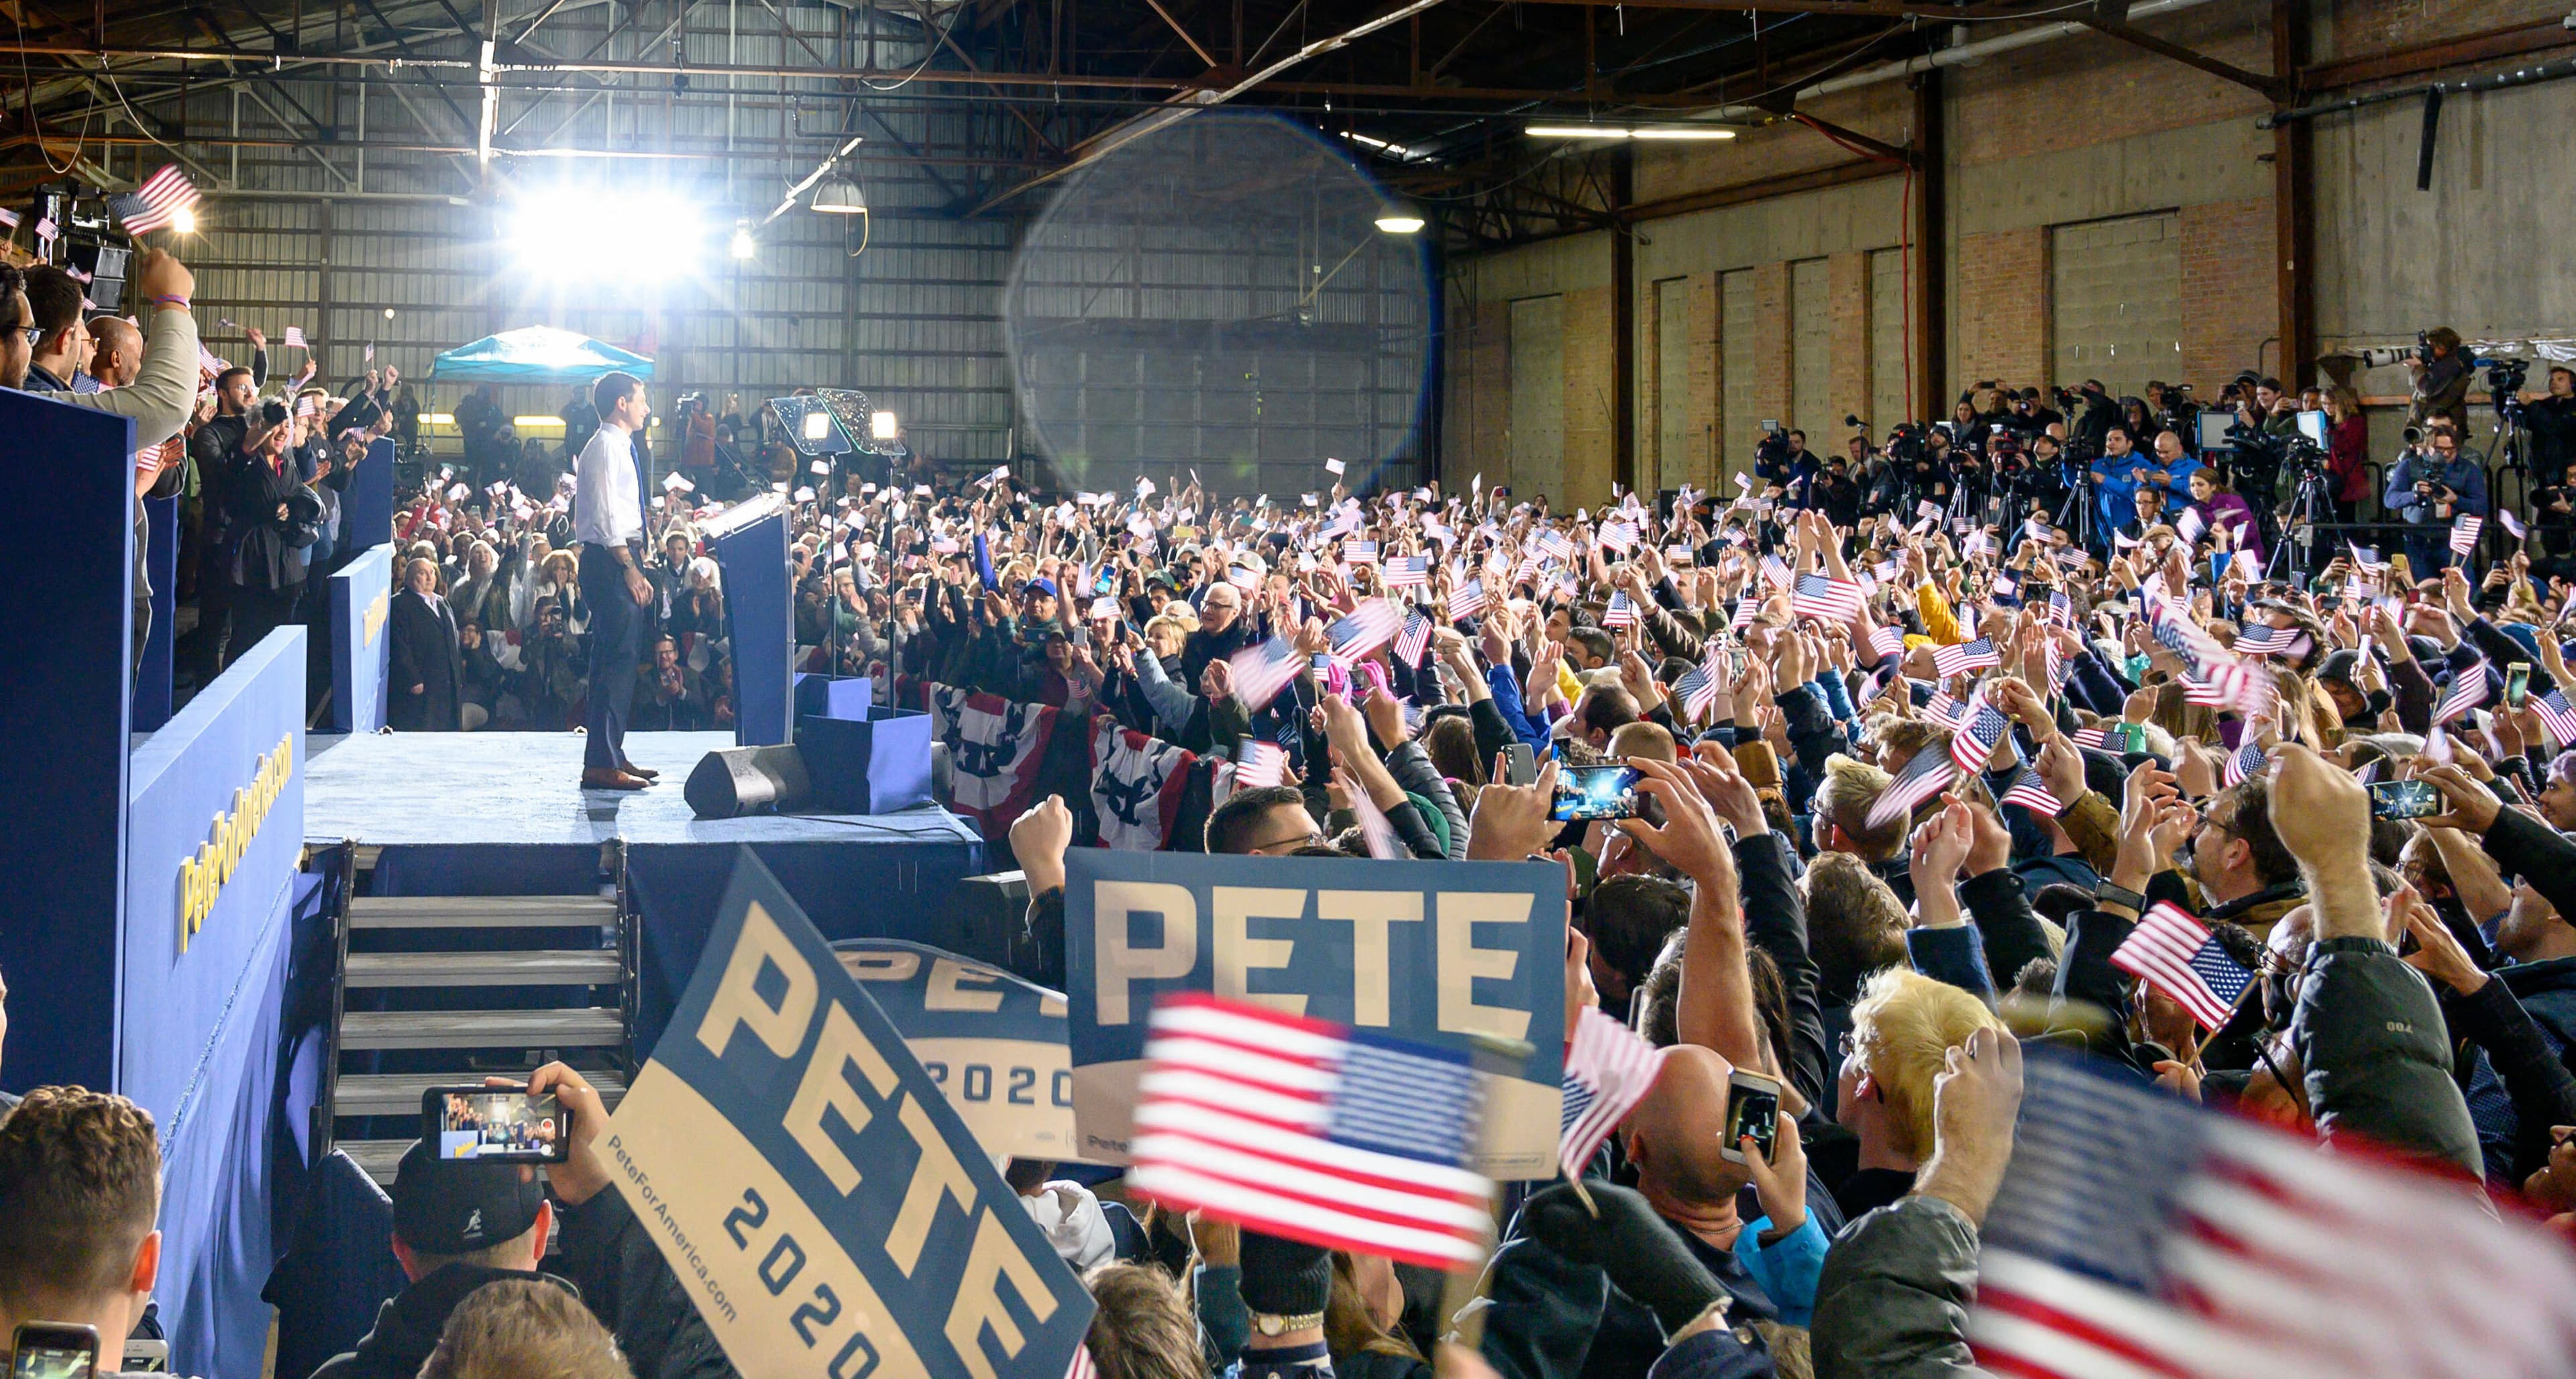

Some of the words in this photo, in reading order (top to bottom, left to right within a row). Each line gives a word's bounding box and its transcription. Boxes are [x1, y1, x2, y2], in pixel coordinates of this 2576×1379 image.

[1094, 880, 1536, 1041] PETE
[608, 1134, 737, 1323] PeteForAmerica.com
[696, 901, 1059, 1379] PETE
[722, 1187, 880, 1379] 2020
